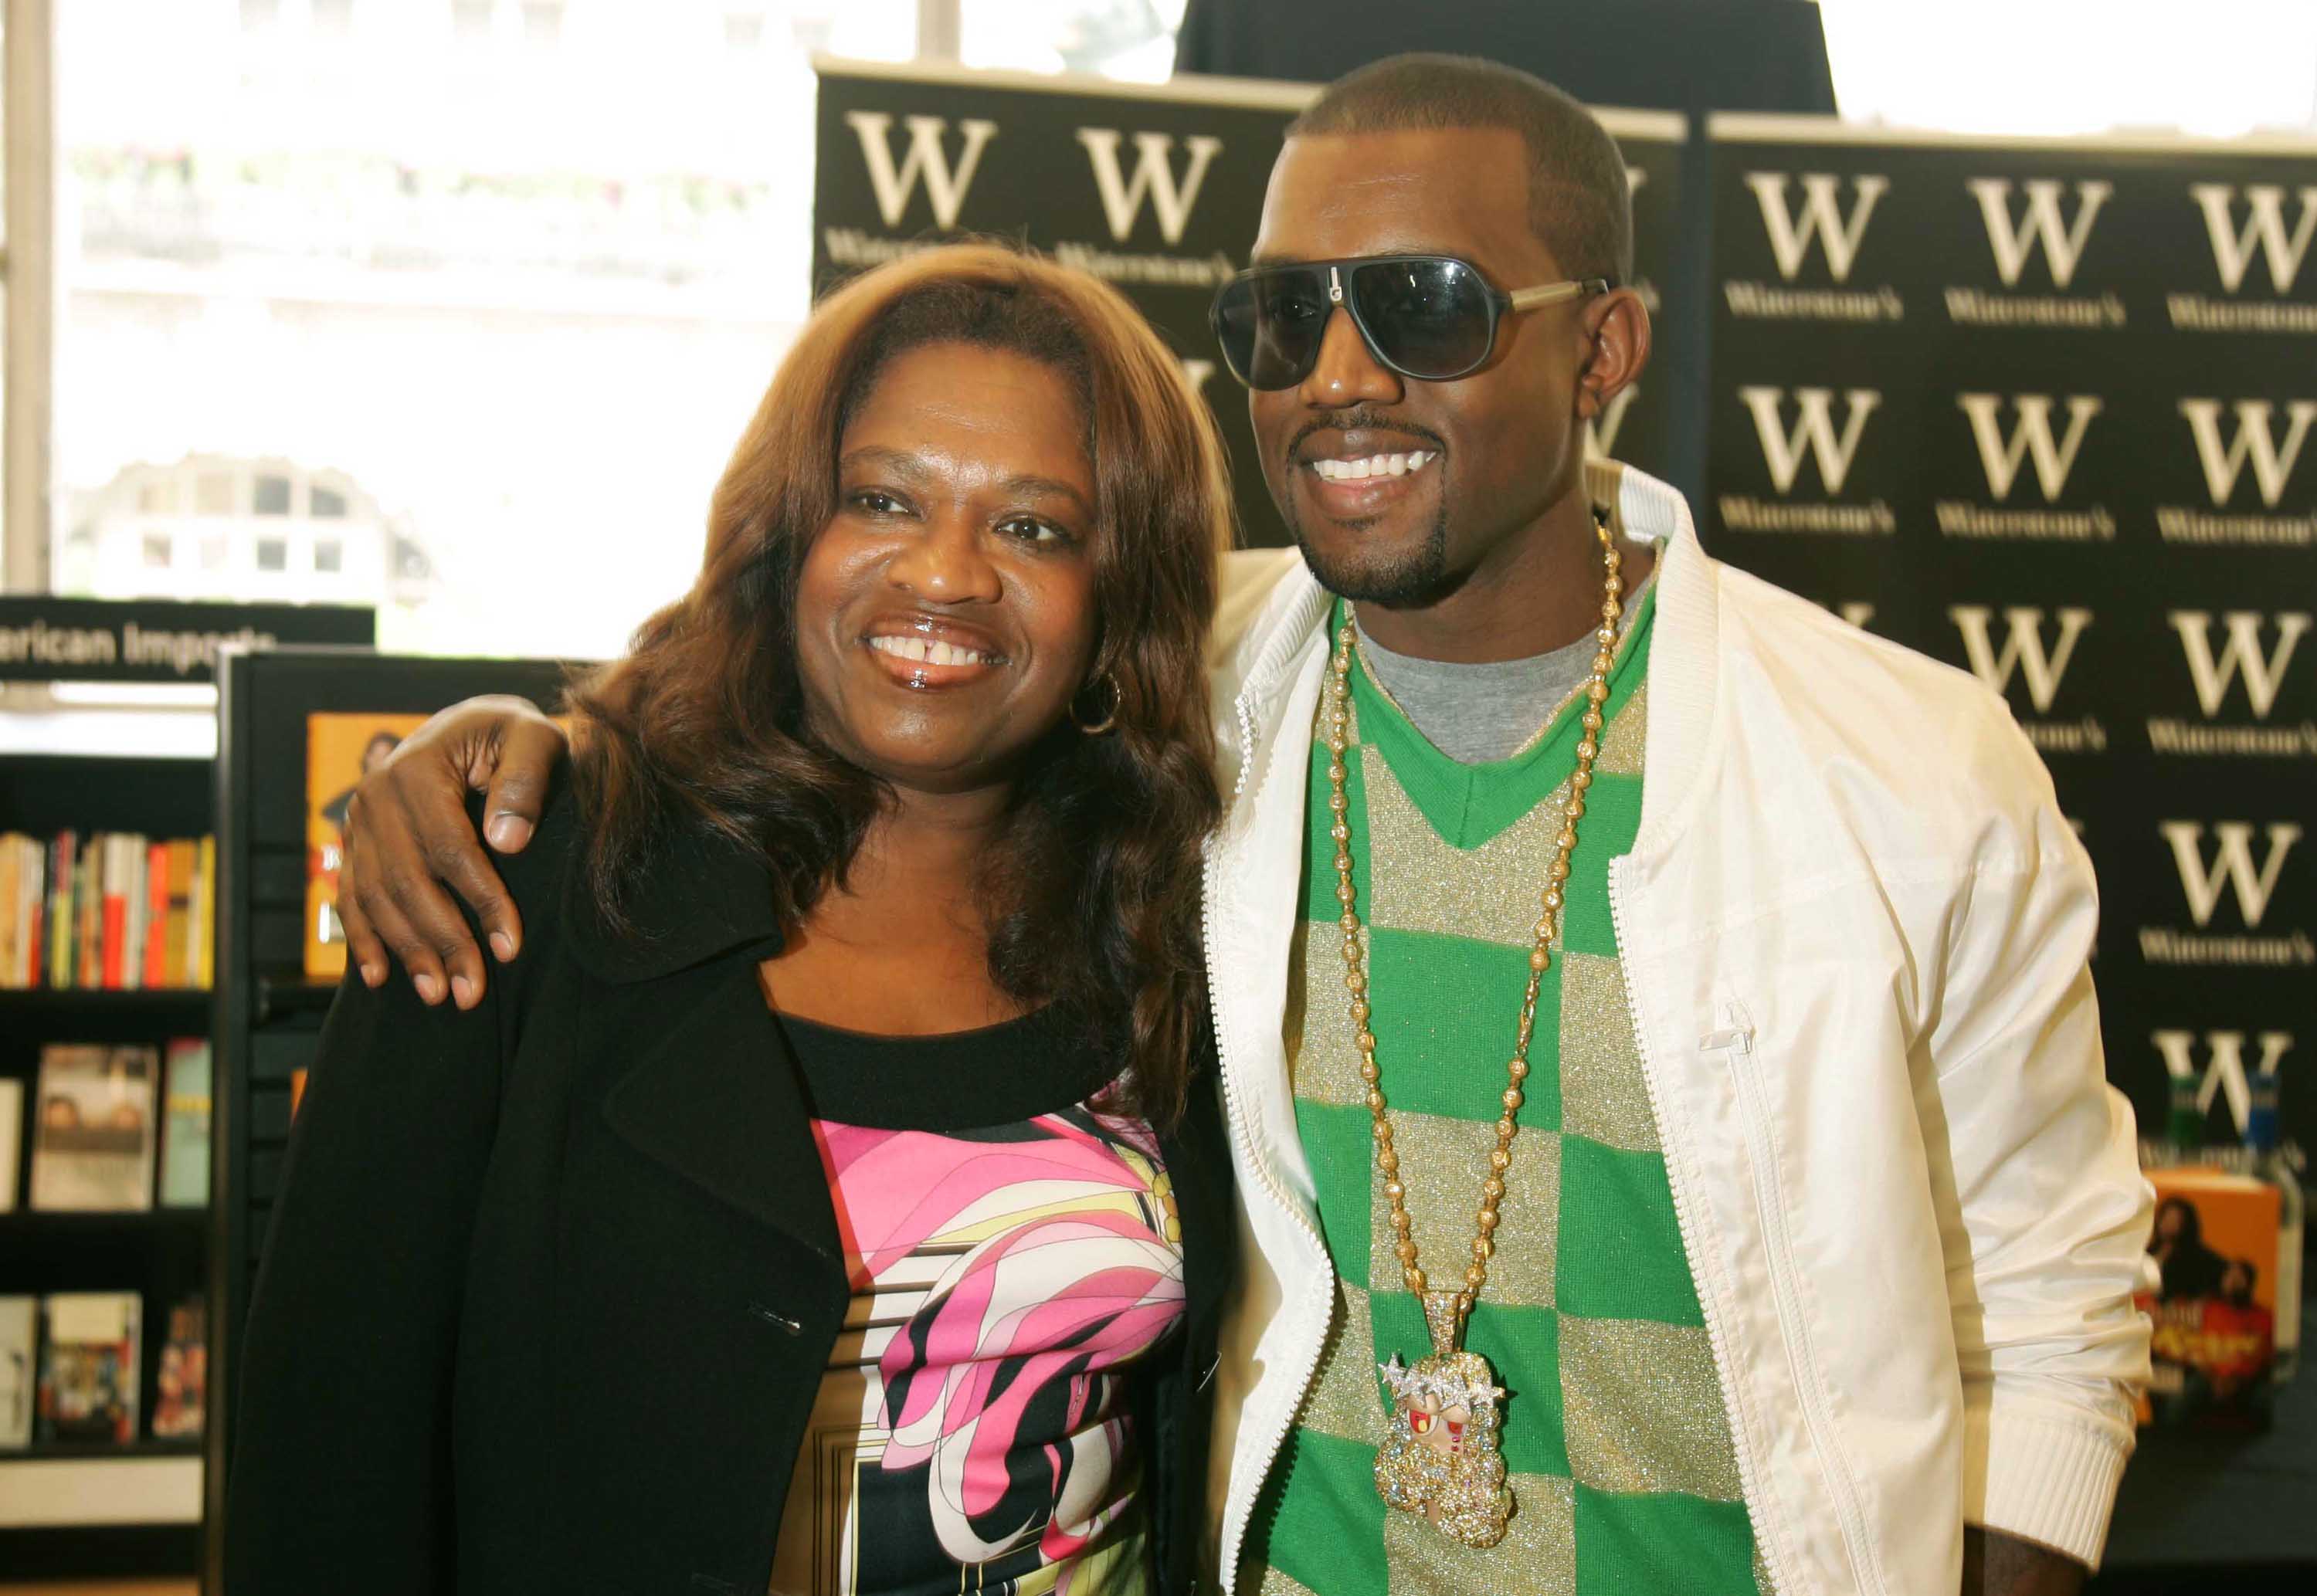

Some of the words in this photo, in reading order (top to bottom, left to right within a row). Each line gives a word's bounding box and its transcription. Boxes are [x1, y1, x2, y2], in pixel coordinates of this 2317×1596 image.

[845, 111, 996, 230] W
[1077, 128, 1222, 245] W
[1746, 173, 1888, 280] W
[1969, 178, 2112, 285] W
[2190, 184, 2317, 292] W
[1741, 387, 1880, 493] W
[1961, 395, 2101, 500] W
[2180, 399, 2317, 507] W
[1949, 605, 2091, 712] W
[2169, 612, 2311, 717] W
[2162, 822, 2301, 927] W
[2152, 1032, 2291, 1135] W
